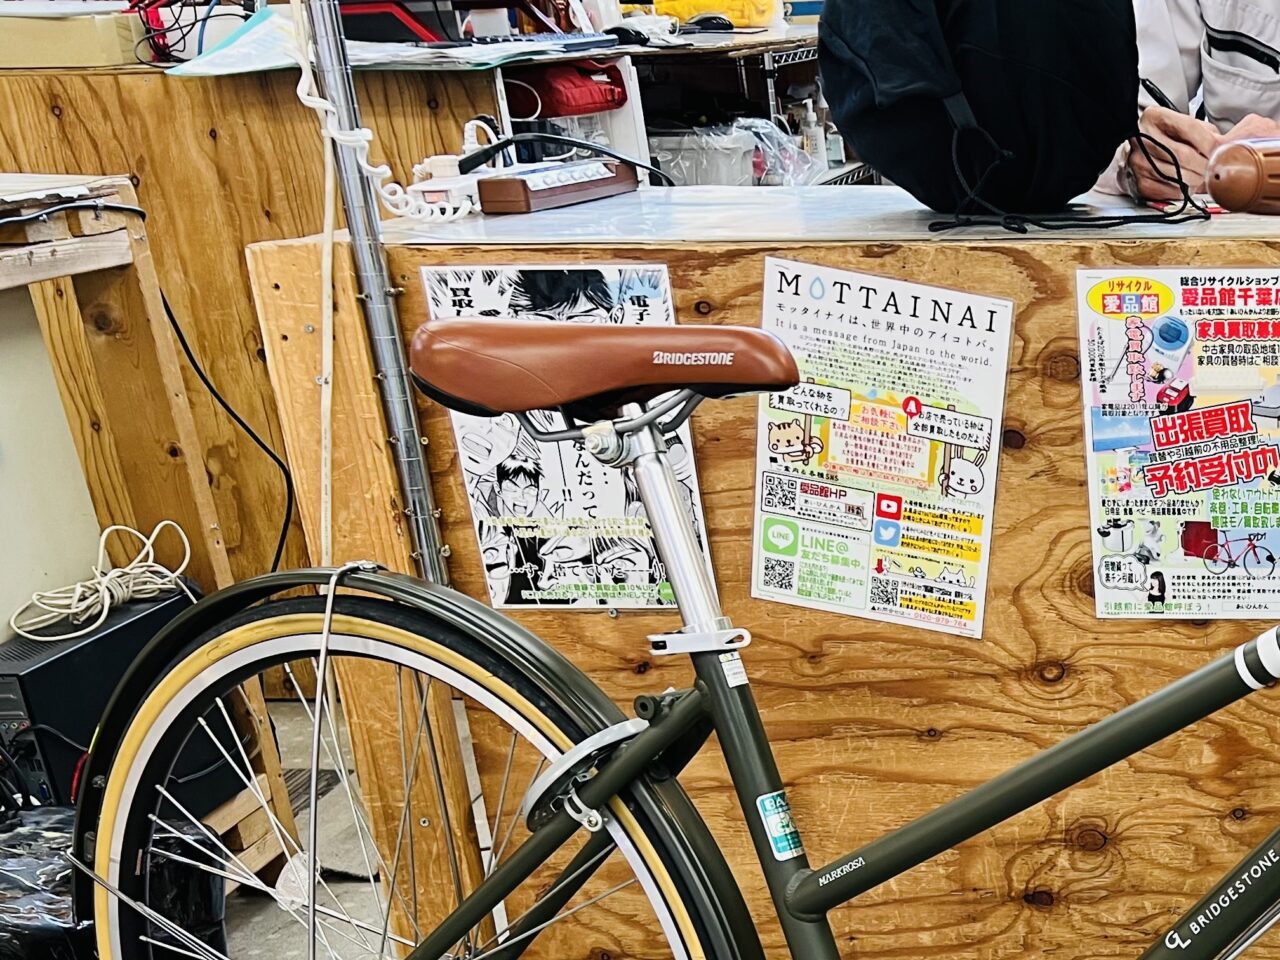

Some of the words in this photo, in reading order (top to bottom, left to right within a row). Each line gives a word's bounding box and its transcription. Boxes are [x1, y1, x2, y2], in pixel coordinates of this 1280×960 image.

[1108, 281, 1152, 292] リサイクル
[1180, 276, 1279, 286] 総合リサイクルショップ
[629, 294, 651, 324] 電子
[1103, 294, 1159, 314] 愛品館
[775, 318, 784, 328] It
[788, 321, 798, 331] is
[813, 326, 858, 342] message
[863, 335, 887, 348] from
[892, 339, 920, 354] Japan
[925, 346, 935, 356] to
[939, 348, 956, 360] the
[653, 351, 735, 365] BRIDGESTONE
[1152, 403, 1254, 448] 出張買取
[1145, 447, 1280, 497] 予約受付中
[772, 531, 790, 541] LINE
[801, 535, 849, 554] LINE@
[818, 857, 866, 887] MARKROSA
[1189, 848, 1280, 935] BRIDGESTONE
